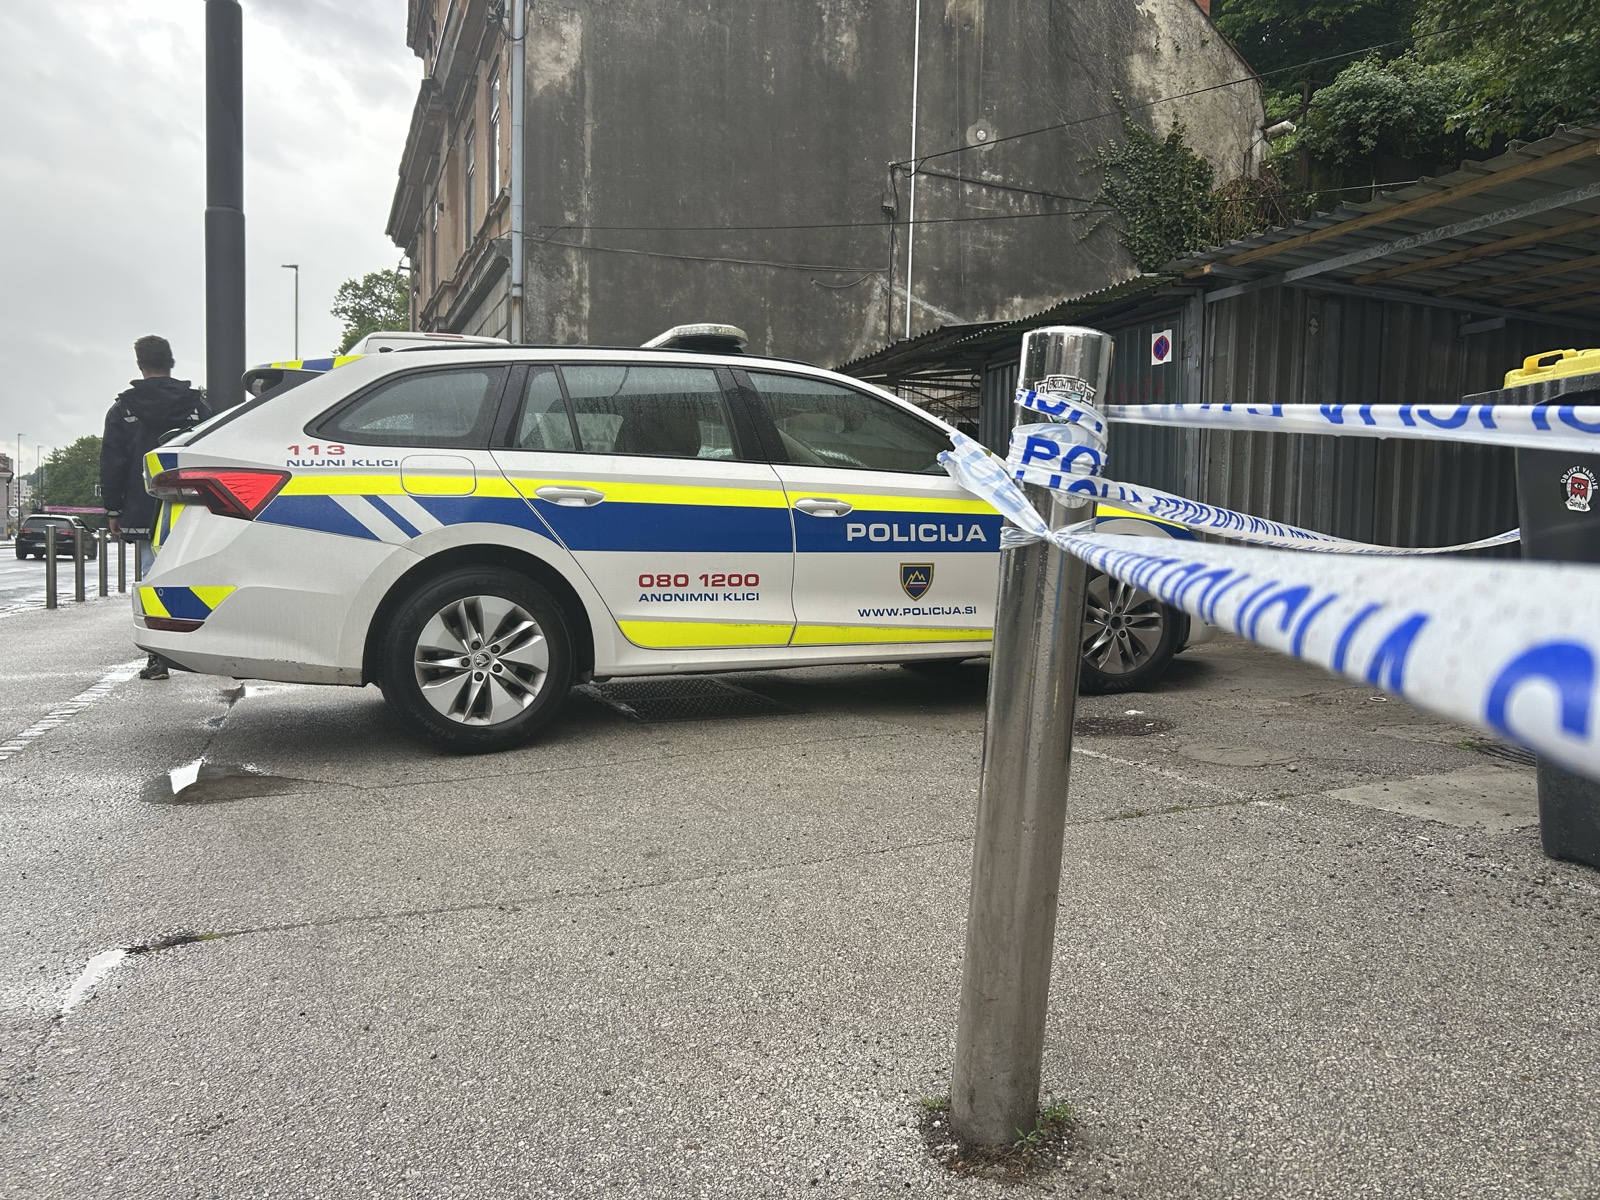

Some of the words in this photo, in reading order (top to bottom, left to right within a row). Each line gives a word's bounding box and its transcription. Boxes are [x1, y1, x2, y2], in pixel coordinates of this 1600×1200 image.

[287, 445, 345, 455] 113
[286, 459, 345, 467] NUJNI
[352, 459, 398, 467] KLICI
[1560, 466, 1580, 484] OBJEKT
[1582, 466, 1598, 490] VARUJE
[846, 523, 987, 542] POLICIJA
[638, 574, 689, 588] 080
[698, 573, 760, 588] 1200
[638, 593, 718, 602] ANONIMNI
[723, 592, 760, 601] KLICI
[857, 606, 977, 617] WWW.POLICIJA.SI
